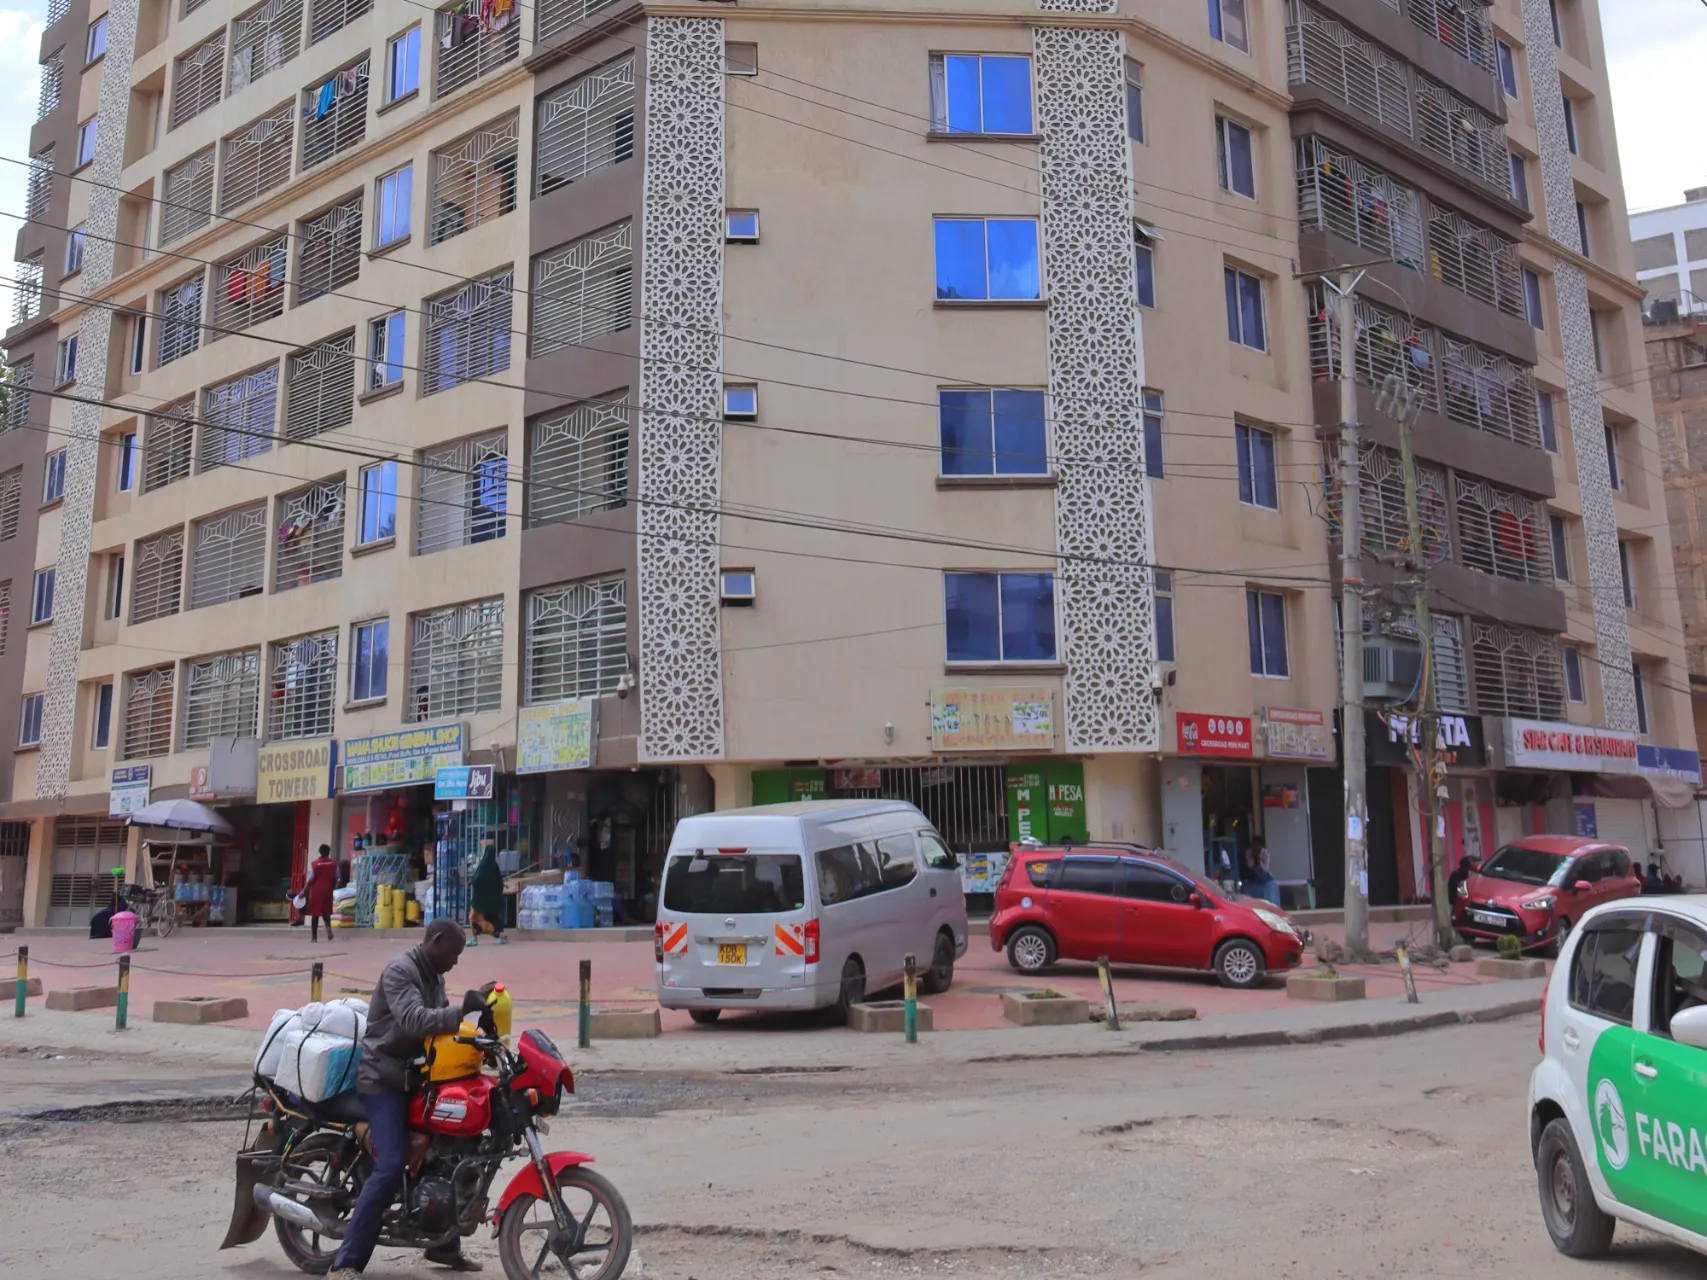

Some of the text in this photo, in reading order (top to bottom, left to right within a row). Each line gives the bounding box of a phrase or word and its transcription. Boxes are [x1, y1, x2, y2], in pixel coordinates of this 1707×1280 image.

[347, 741, 370, 757] MAMA
[401, 730, 434, 748] GENERAL
[437, 727, 459, 744] SHOP
[1201, 739, 1227, 749] CROSSROAD
[1237, 741, 1250, 750] MART
[1523, 729, 1637, 759] STAR CAFE & RESTAURANT
[259, 747, 328, 773] CROSSROAD
[268, 776, 317, 798] TOWERS
[1635, 1111, 1707, 1176] FARA
